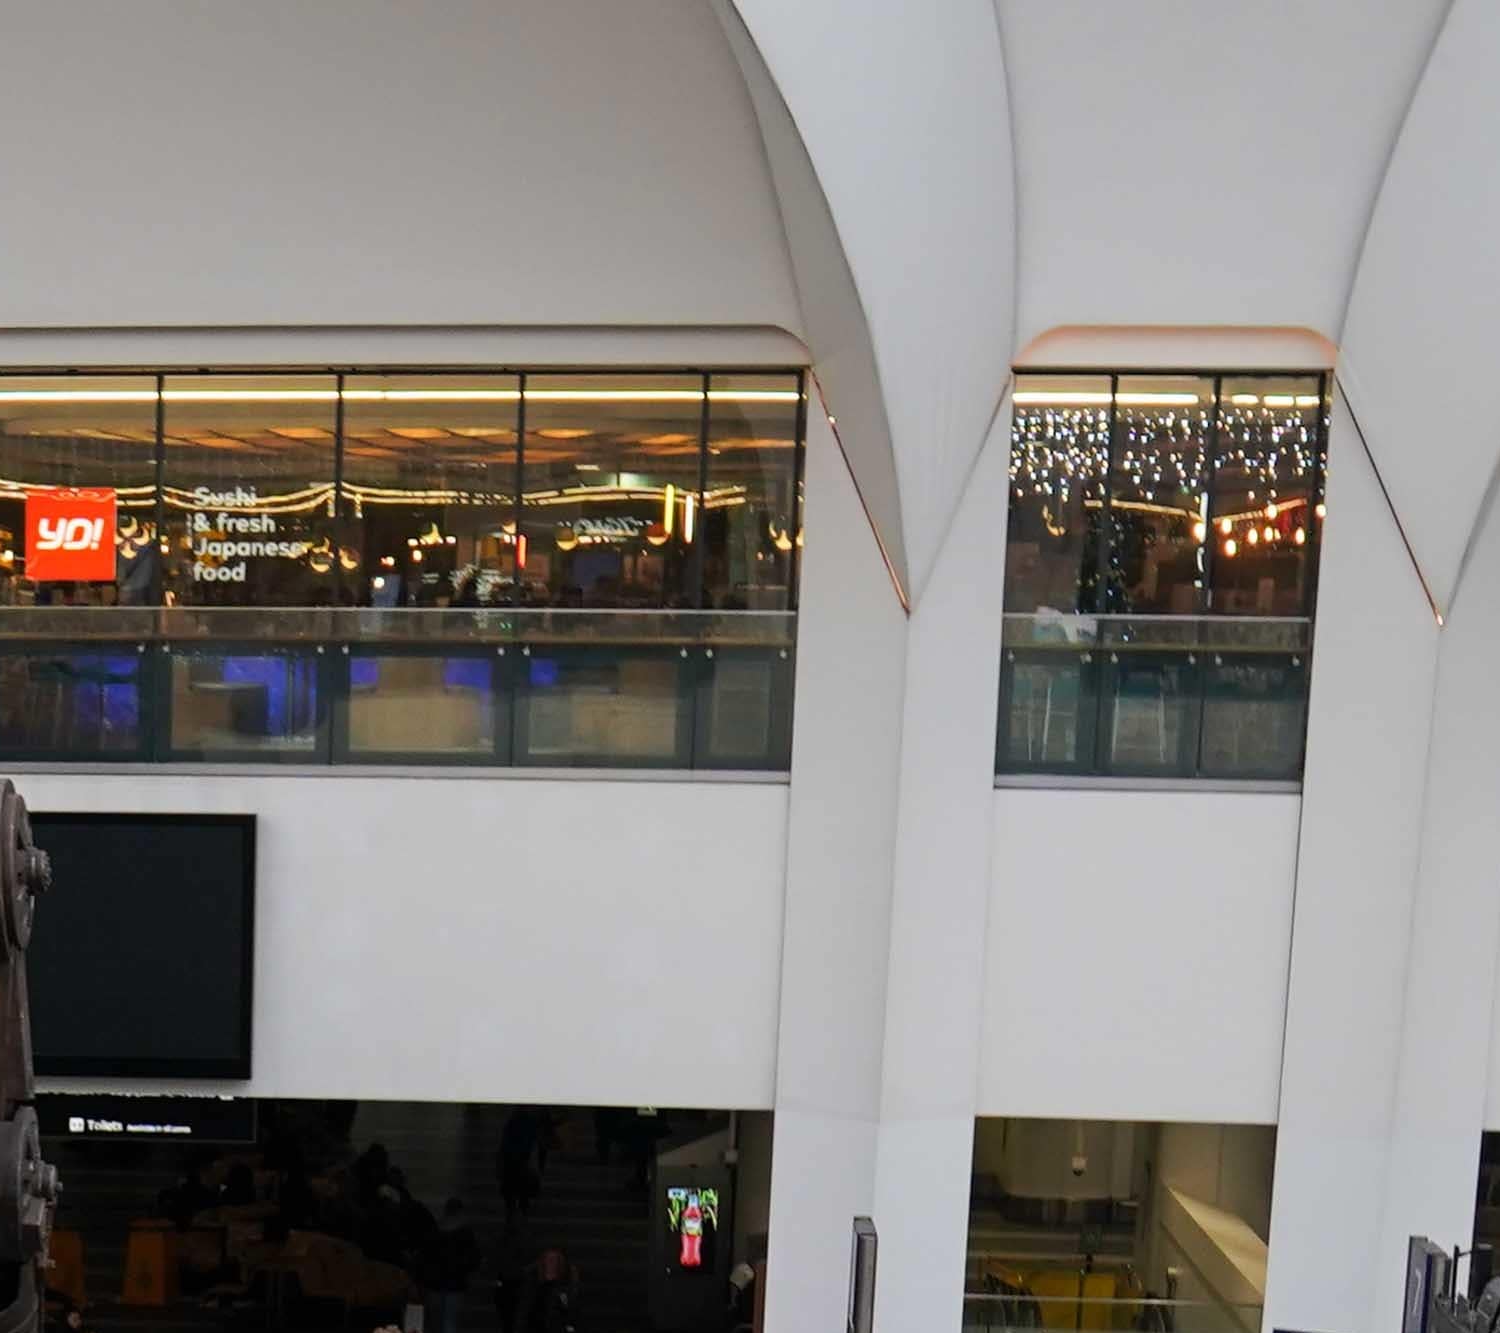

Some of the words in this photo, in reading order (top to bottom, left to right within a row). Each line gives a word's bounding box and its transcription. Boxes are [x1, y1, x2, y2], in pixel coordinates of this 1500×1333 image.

[193, 486, 257, 508] Sushi
[193, 513, 211, 533] &
[216, 513, 276, 533] fresh
[36, 517, 105, 550] YO!
[193, 539, 303, 558] Japanese
[192, 562, 247, 582] food
